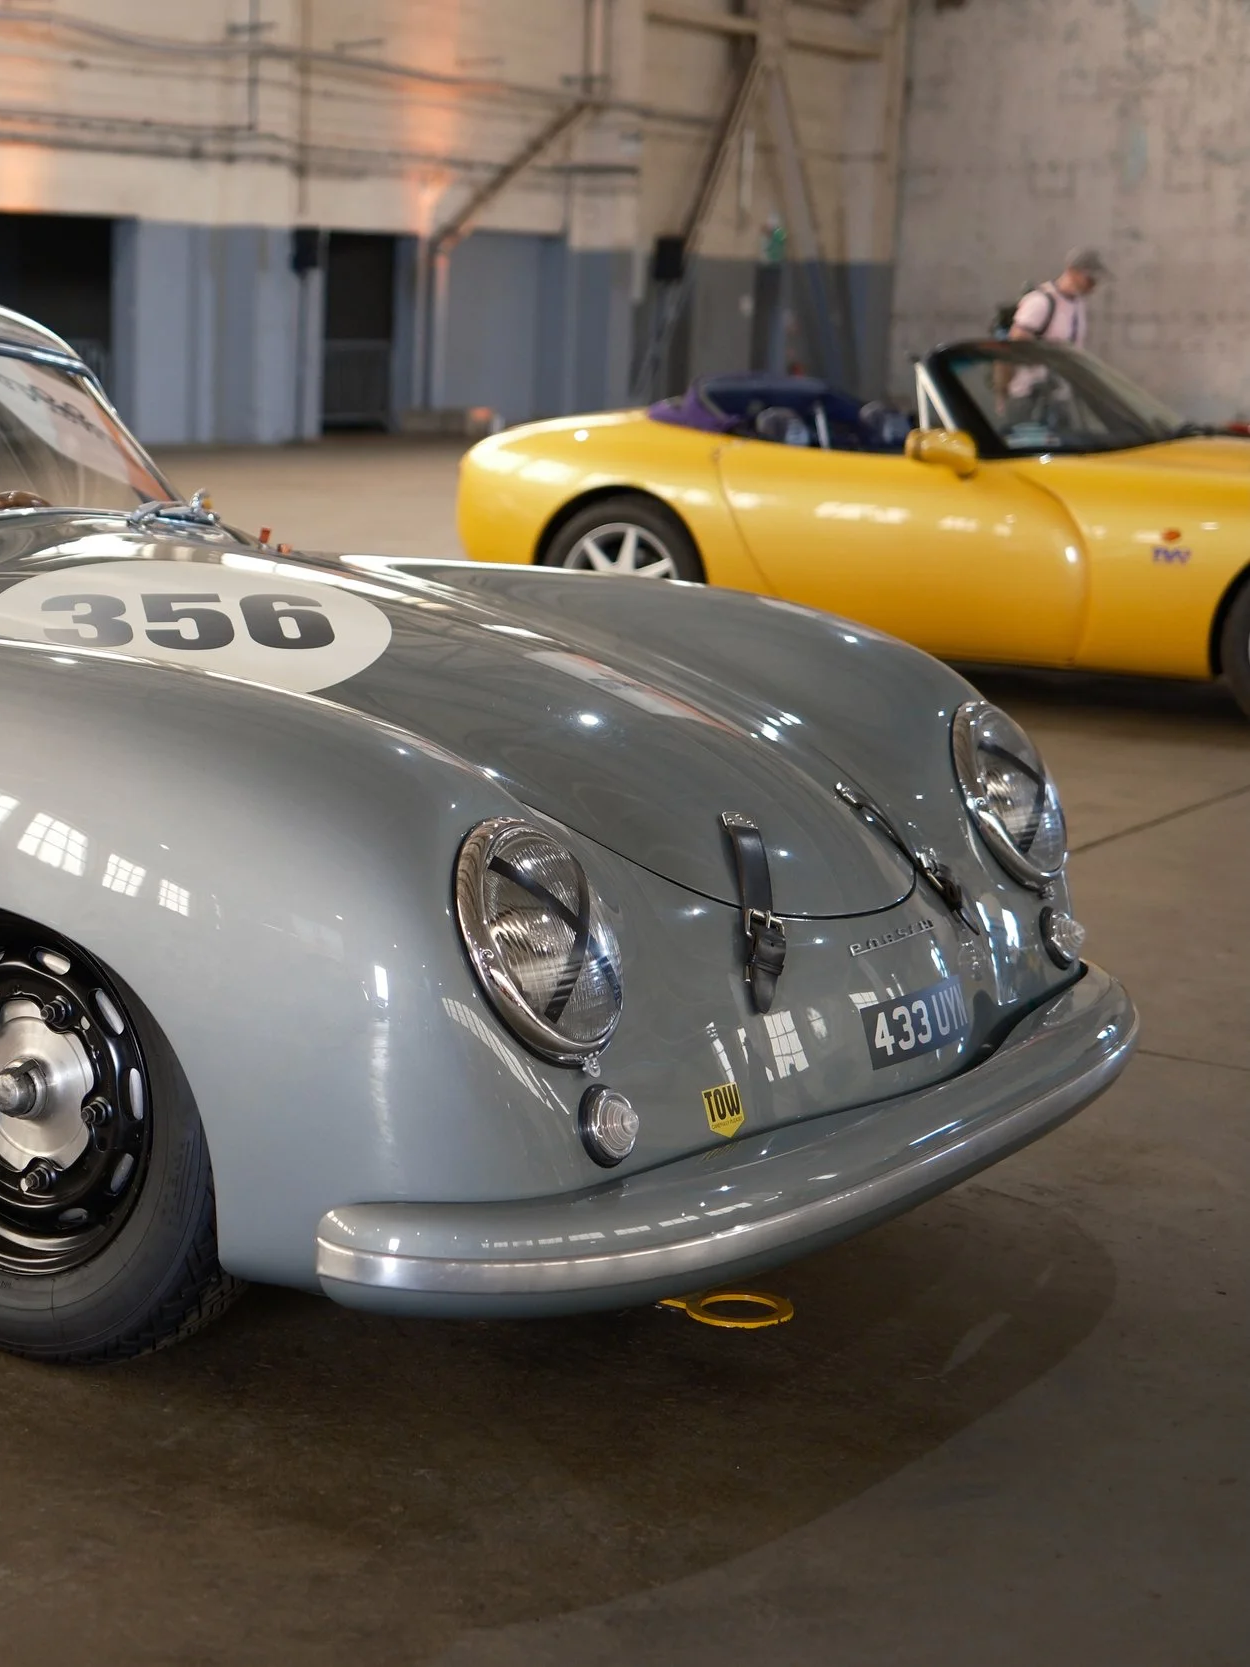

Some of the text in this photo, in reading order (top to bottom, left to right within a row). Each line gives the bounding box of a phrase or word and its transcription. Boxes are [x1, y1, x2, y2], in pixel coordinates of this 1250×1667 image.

[41, 593, 336, 651] 356
[849, 919, 934, 956] PORSCH
[874, 982, 968, 1057] 433 UYN
[703, 1083, 741, 1123] TOW
